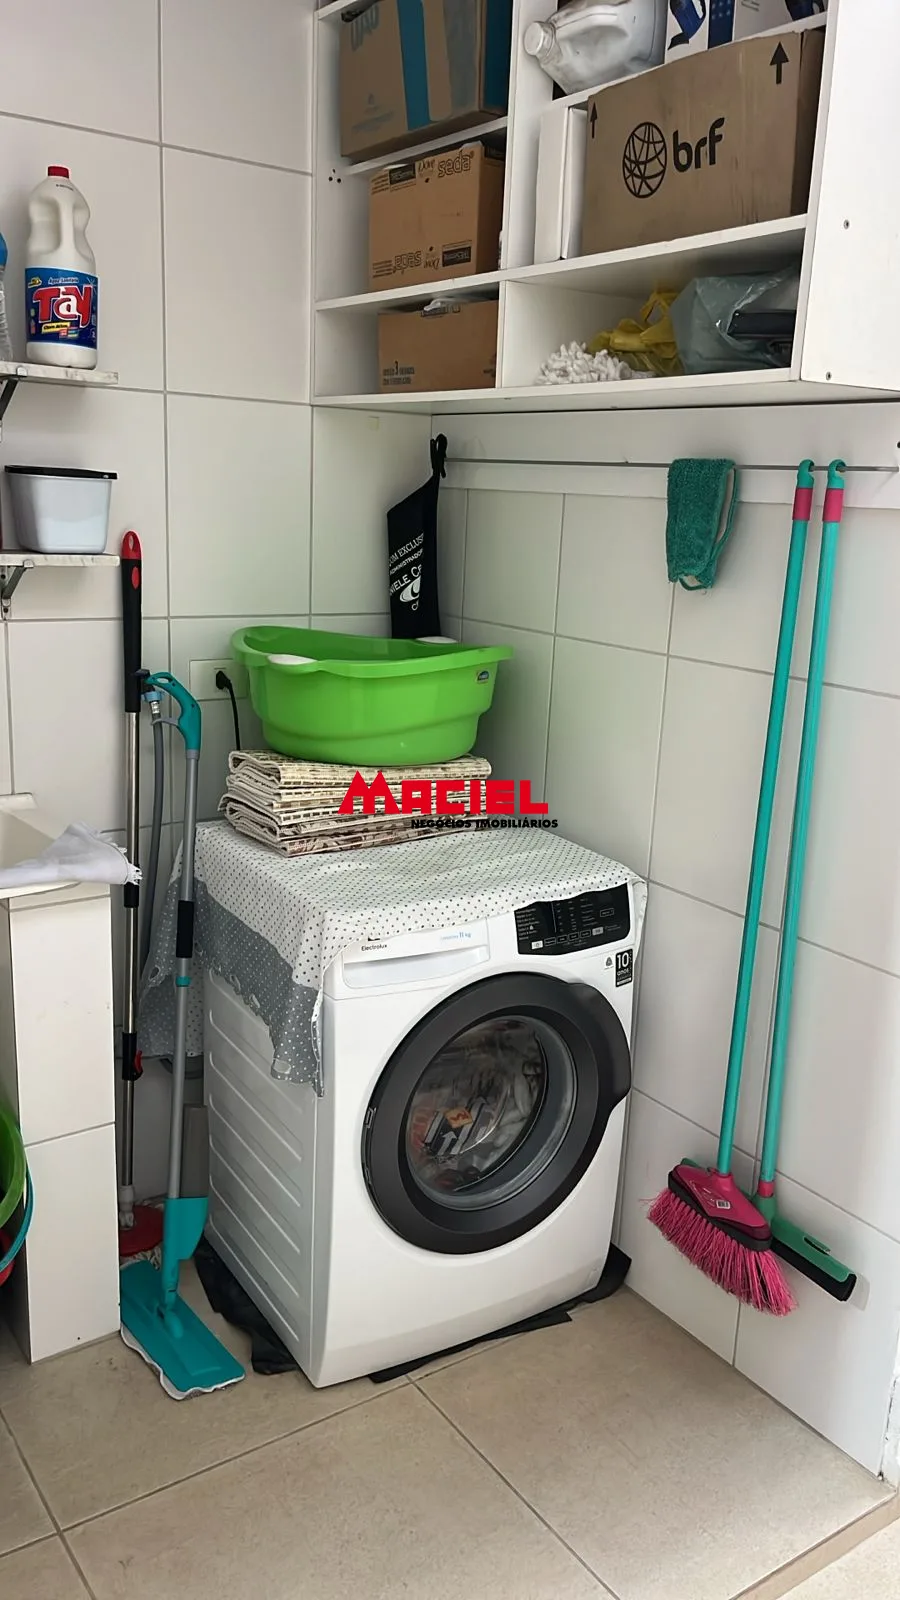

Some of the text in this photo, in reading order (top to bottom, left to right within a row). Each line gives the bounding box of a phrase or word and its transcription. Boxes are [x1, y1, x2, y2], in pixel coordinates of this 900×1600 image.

[673, 117, 725, 173] brf
[438, 149, 471, 178] seda
[361, 943, 388, 952] Electrolux
[616, 952, 630, 969] 10
